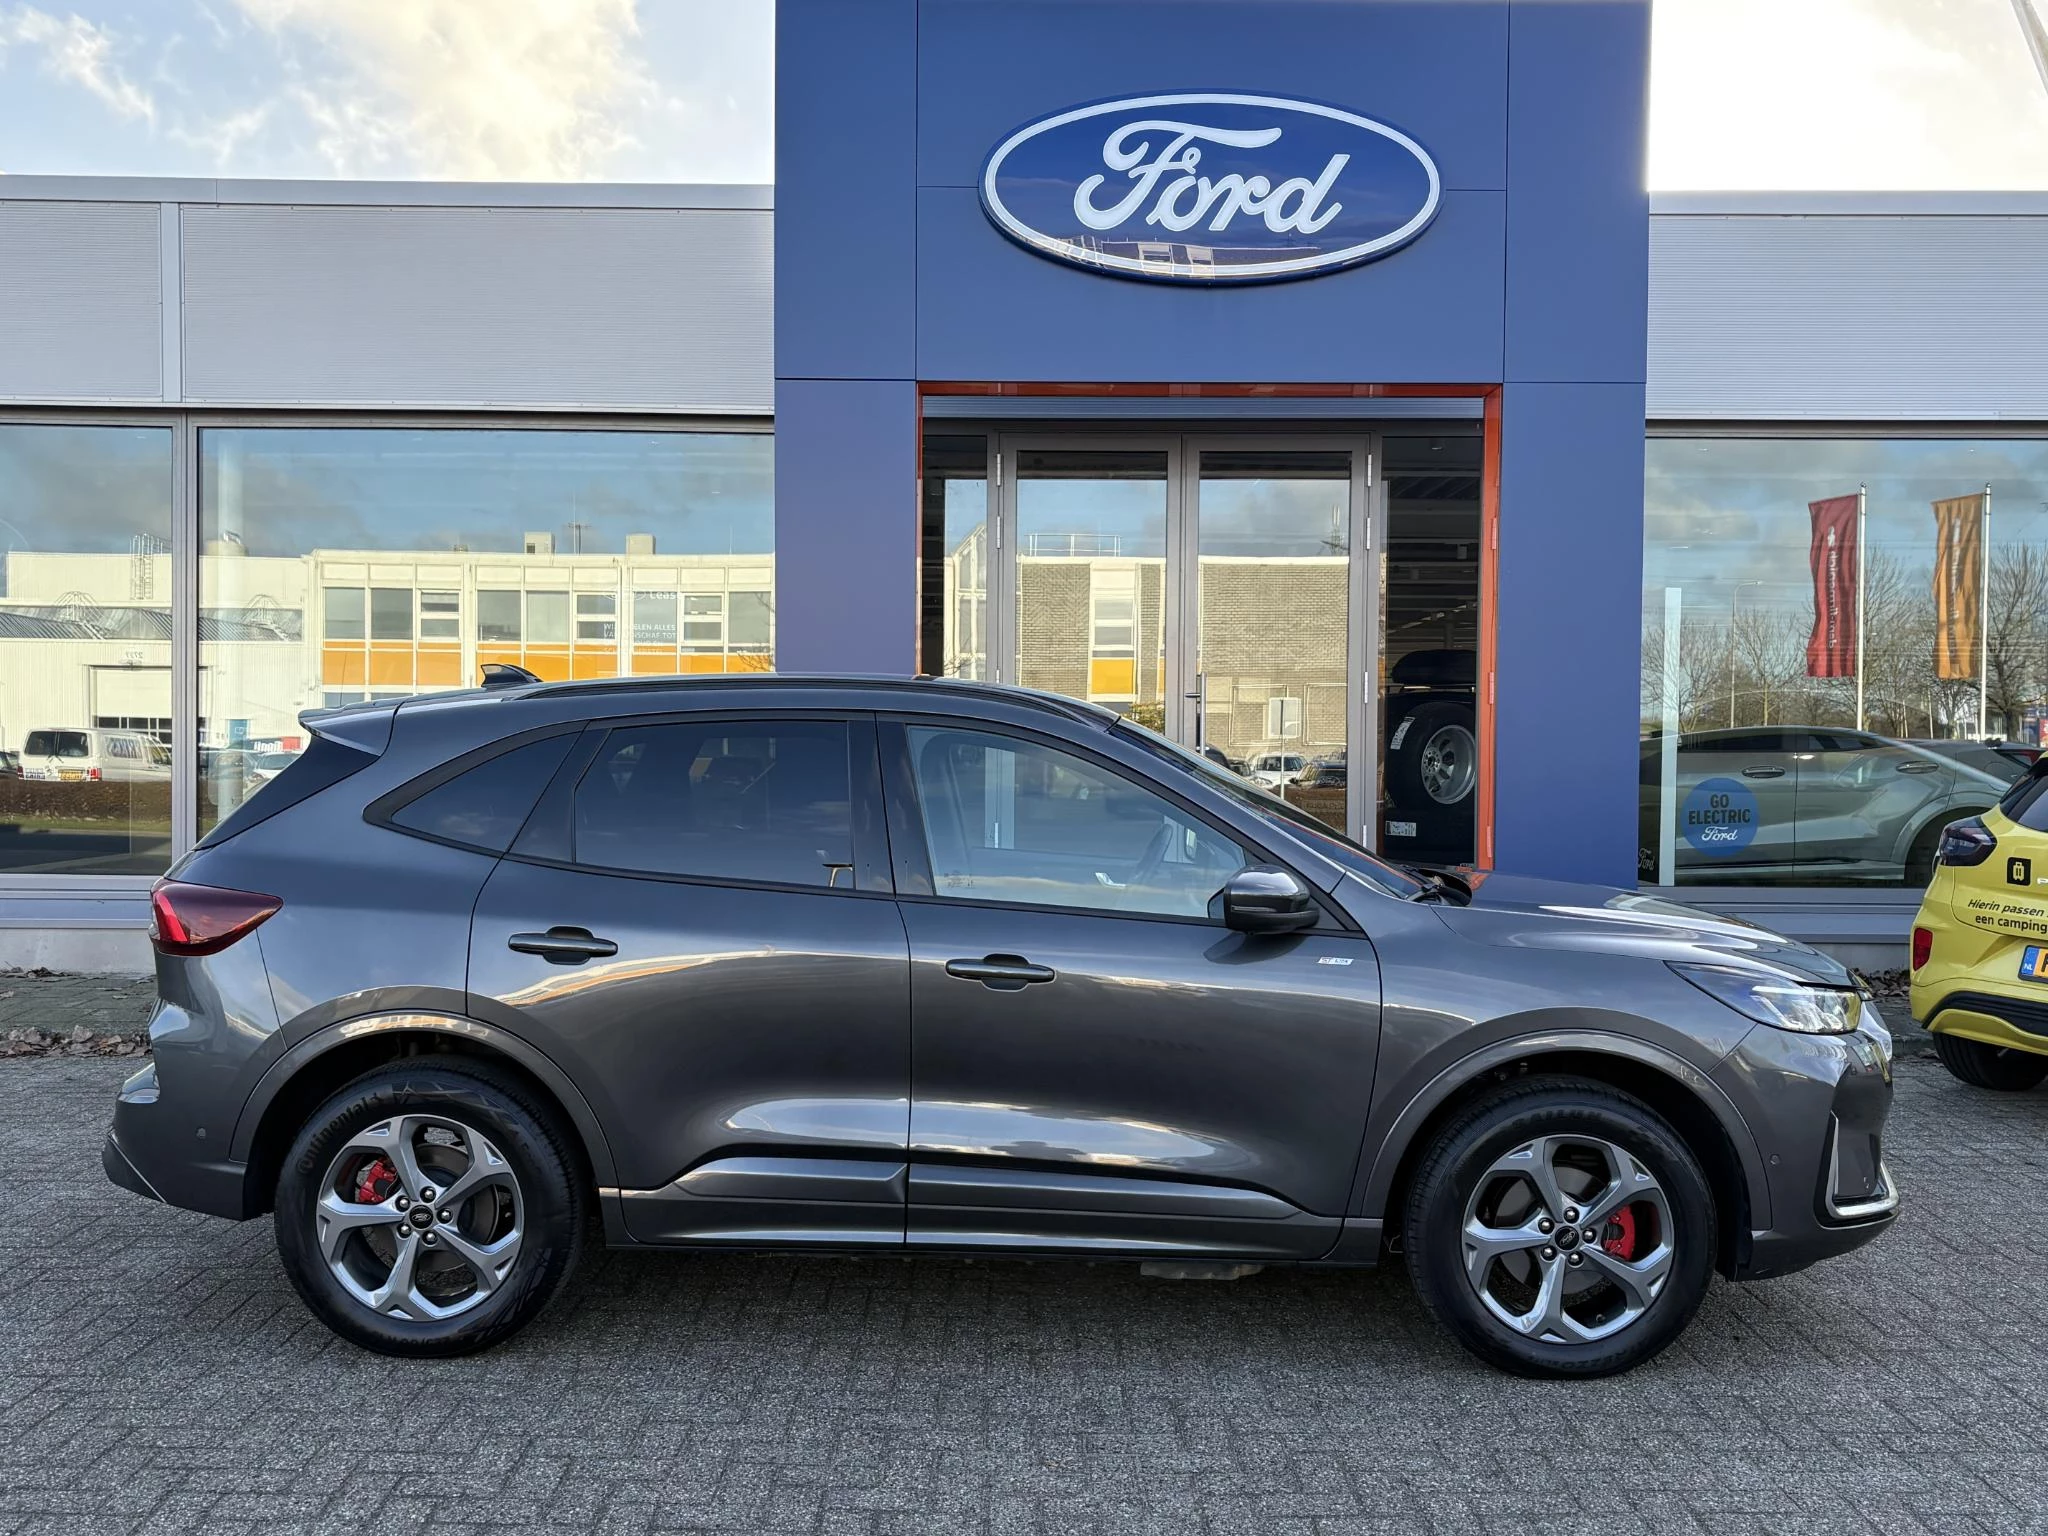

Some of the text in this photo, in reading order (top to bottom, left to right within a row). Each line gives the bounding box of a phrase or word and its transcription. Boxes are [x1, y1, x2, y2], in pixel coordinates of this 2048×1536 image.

[1073, 119, 1351, 235] Ford
[649, 592, 683, 600] Leas
[653, 623, 676, 631] ALLES
[1710, 793, 1730, 809] GO
[1688, 809, 1751, 825] ELECTRIC
[1701, 826, 1738, 841] Ford
[1967, 898, 2045, 917] Hierin passen
[1975, 914, 1994, 926] een
[2023, 962, 2033, 971] NL
